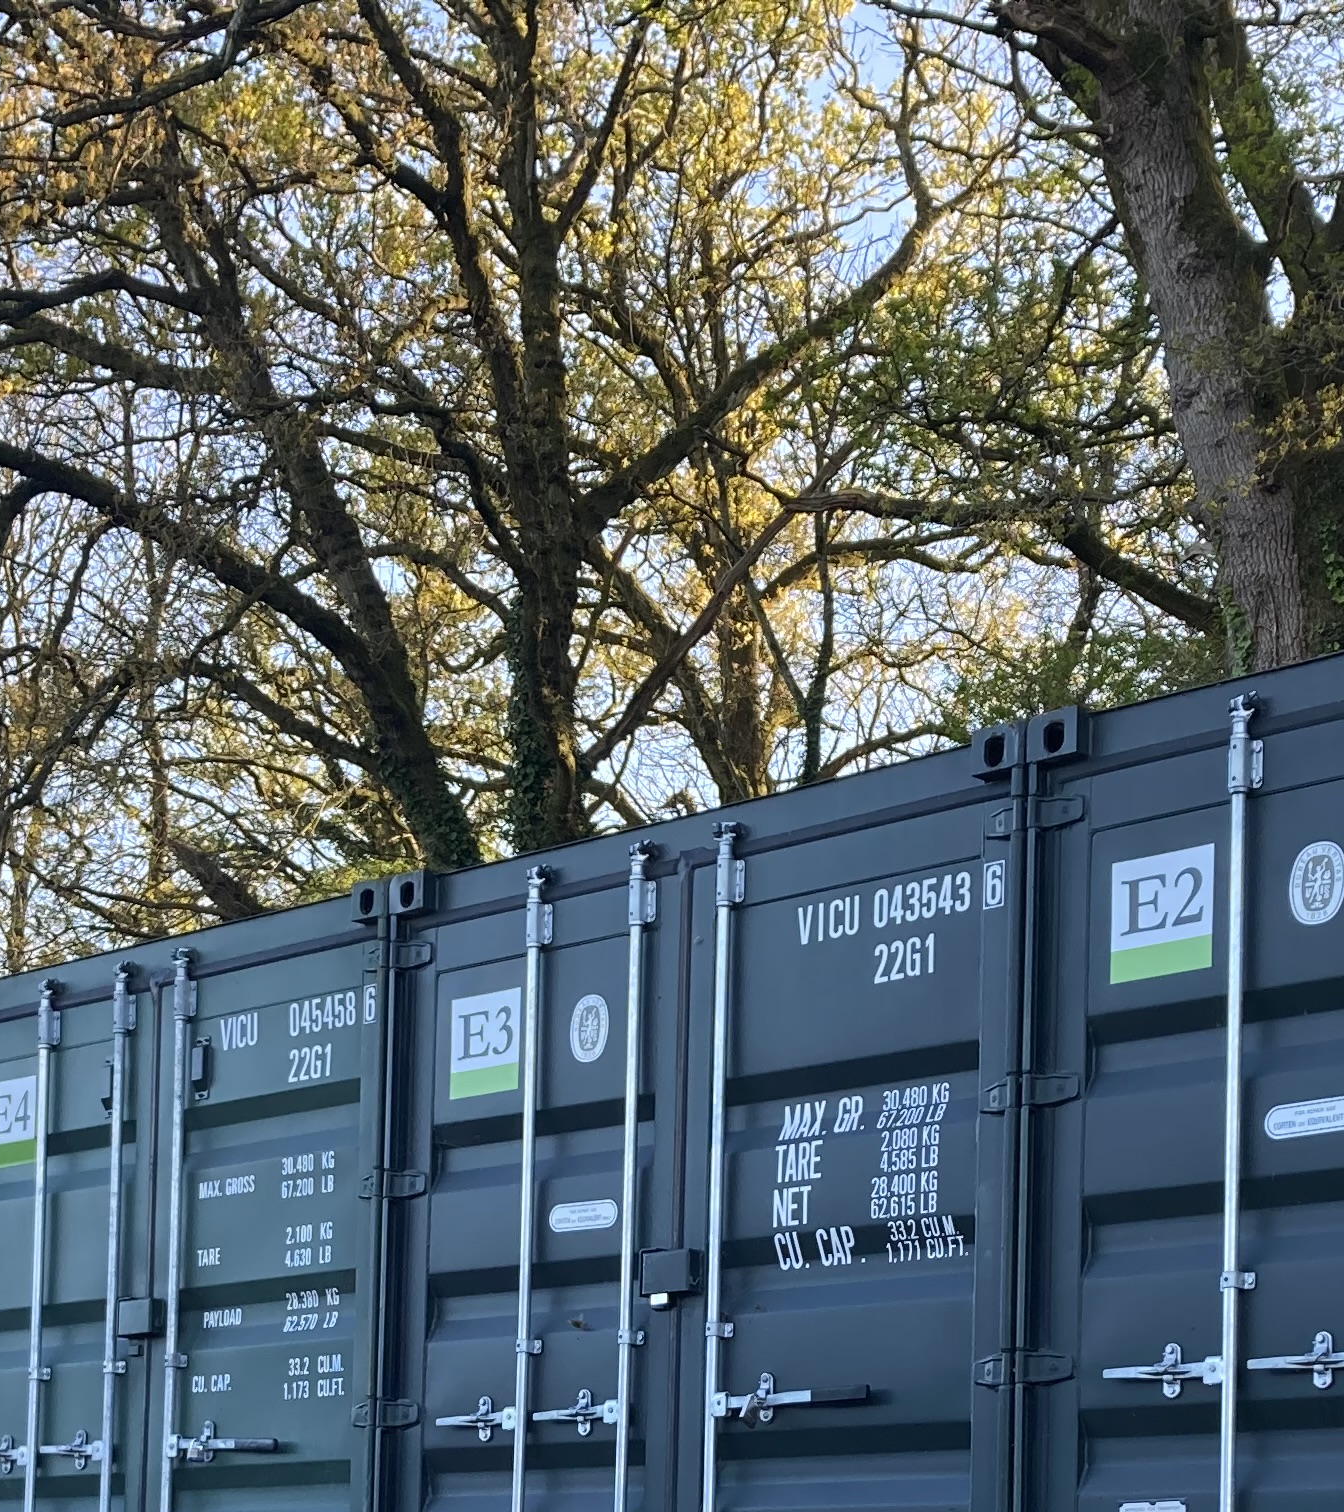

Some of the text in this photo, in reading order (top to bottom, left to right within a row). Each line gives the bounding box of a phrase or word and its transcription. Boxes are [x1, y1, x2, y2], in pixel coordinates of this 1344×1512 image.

[798, 862, 1004, 946] VICU 043543 6
[1120, 867, 1203, 937] E2
[873, 932, 935, 984] 22G1
[220, 985, 376, 1051] VICU 045458 6
[456, 1005, 513, 1061] E3
[288, 1042, 332, 1083] 22G1
[932, 1082, 950, 1104] KG
[778, 1095, 865, 1141] MAX. GR.
[925, 1103, 947, 1123] LB
[922, 1124, 940, 1146] KG
[321, 1151, 335, 1170] KG
[775, 1139, 824, 1183] TARE
[921, 1146, 939, 1168] LB
[198, 1175, 255, 1200] MAX. GROSS
[321, 1174, 334, 1193] LB
[920, 1171, 938, 1193] KG
[772, 1185, 812, 1228] NET
[920, 1193, 937, 1214] LB
[319, 1221, 333, 1240] KG
[887, 1219, 919, 1241] 33.2
[197, 1247, 221, 1267] TARE
[319, 1245, 332, 1264] LB
[773, 1231, 810, 1271] CU.
[325, 1287, 340, 1306] KG
[203, 1308, 242, 1329] PAYLOAD
[323, 1311, 339, 1329] LB
